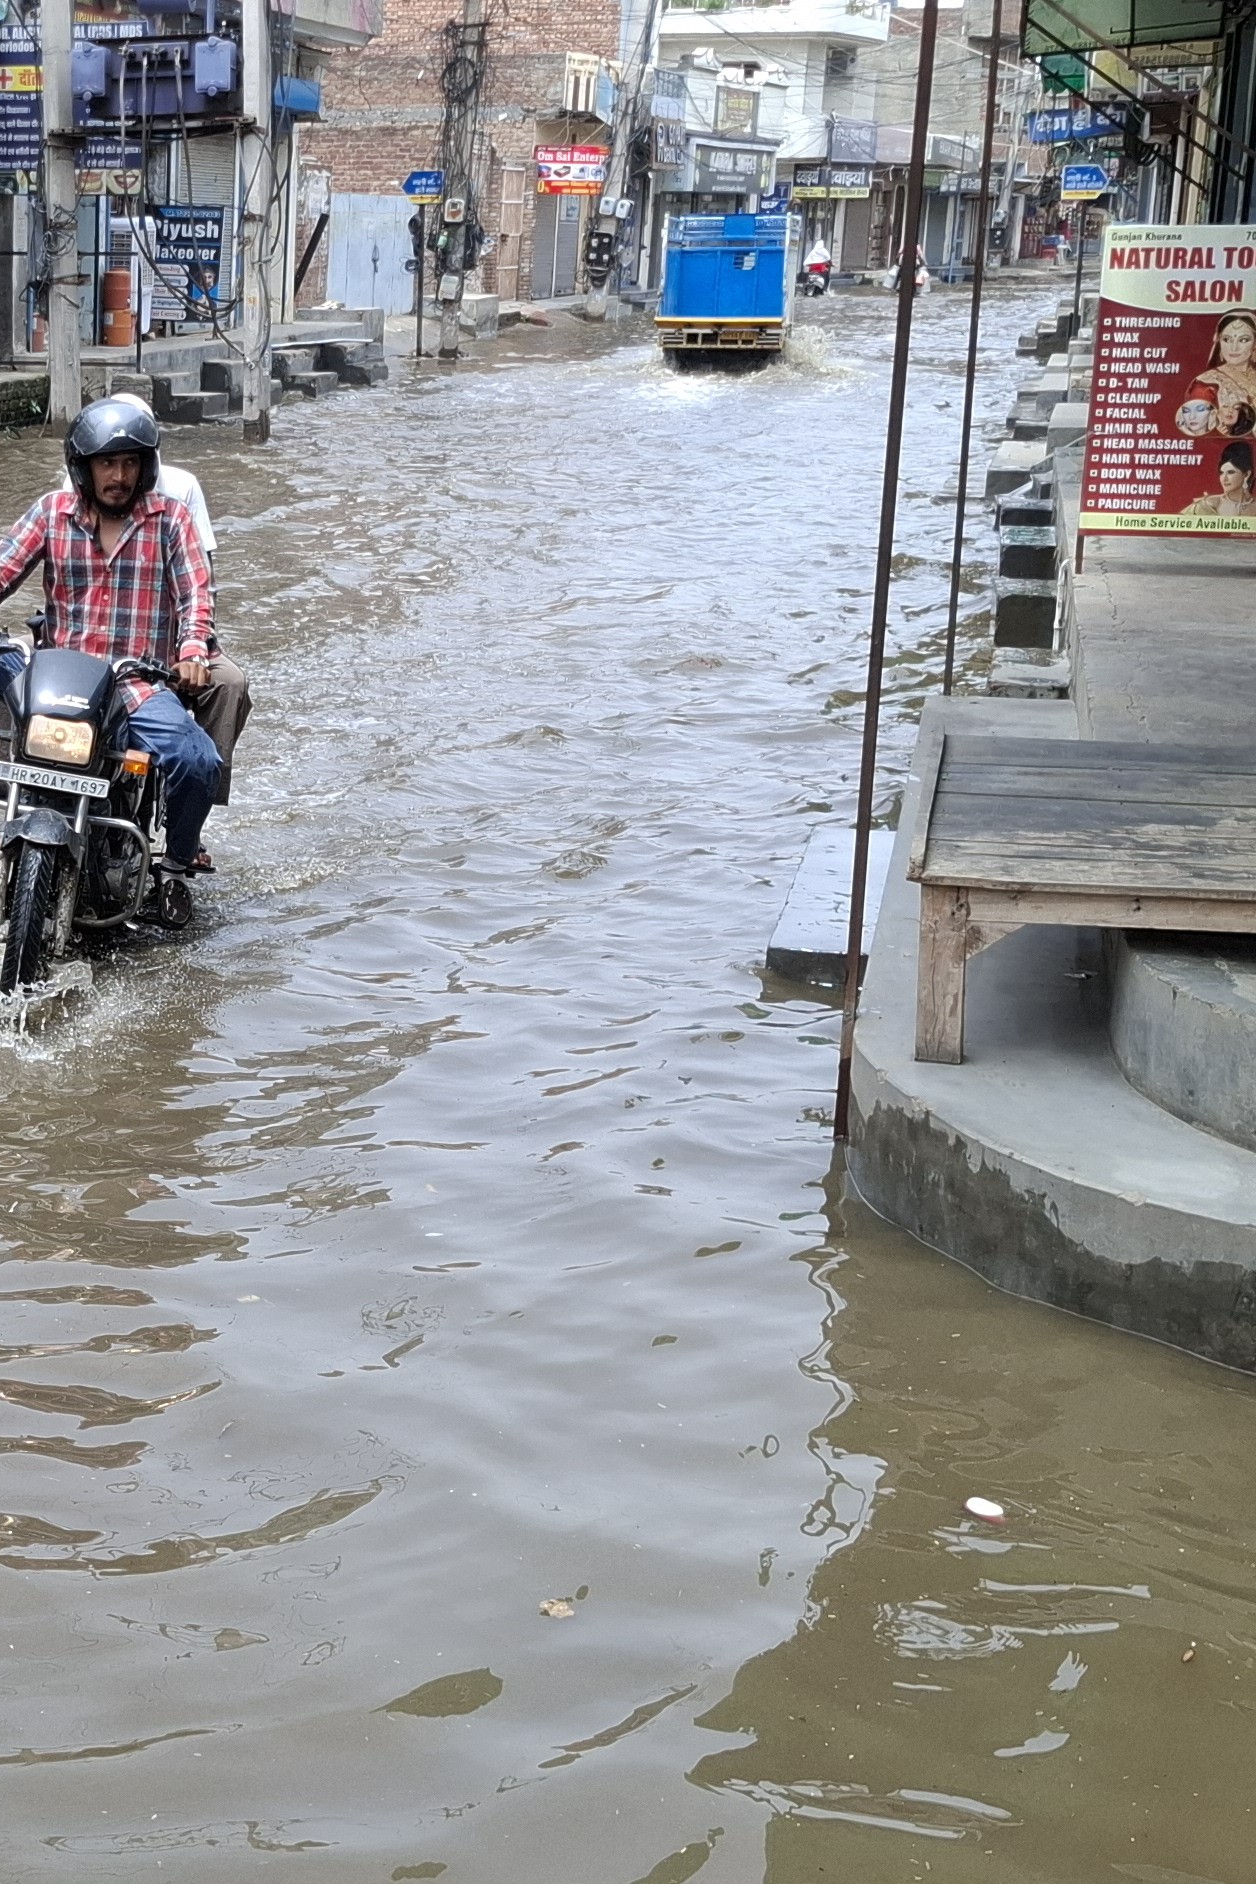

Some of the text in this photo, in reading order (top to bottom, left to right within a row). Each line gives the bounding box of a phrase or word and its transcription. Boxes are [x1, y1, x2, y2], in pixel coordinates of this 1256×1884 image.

[537, 152, 554, 161] Om
[572, 152, 608, 165] Enterp
[1111, 233, 1142, 242] Gunjan
[1145, 233, 1182, 241] Khurana
[155, 245, 216, 260] akeoer
[1109, 245, 1256, 270] NATURAL TO
[1165, 280, 1244, 303] SALON
[1114, 317, 1181, 328] THREADING
[1114, 332, 1139, 343] WAX
[1112, 348, 1168, 358] HAIR CUT
[1110, 363, 1180, 373] HEAD WASH
[1126, 378, 1149, 388] TAN
[1107, 393, 1161, 404] CLEANUP
[1106, 408, 1146, 419] FACIAL
[1104, 423, 1159, 434] HAIR SPA
[1103, 438, 1194, 450] HEAD MASSAGE
[1102, 453, 1204, 465] HAIR TREATMENT
[1100, 468, 1162, 480] BODY WAX
[1099, 484, 1162, 495] MANICURE
[1097, 499, 1157, 510] PADICURE
[1115, 516, 1251, 530] Home Service Available.
[10, 767, 106, 795] HR 20AY 1697
